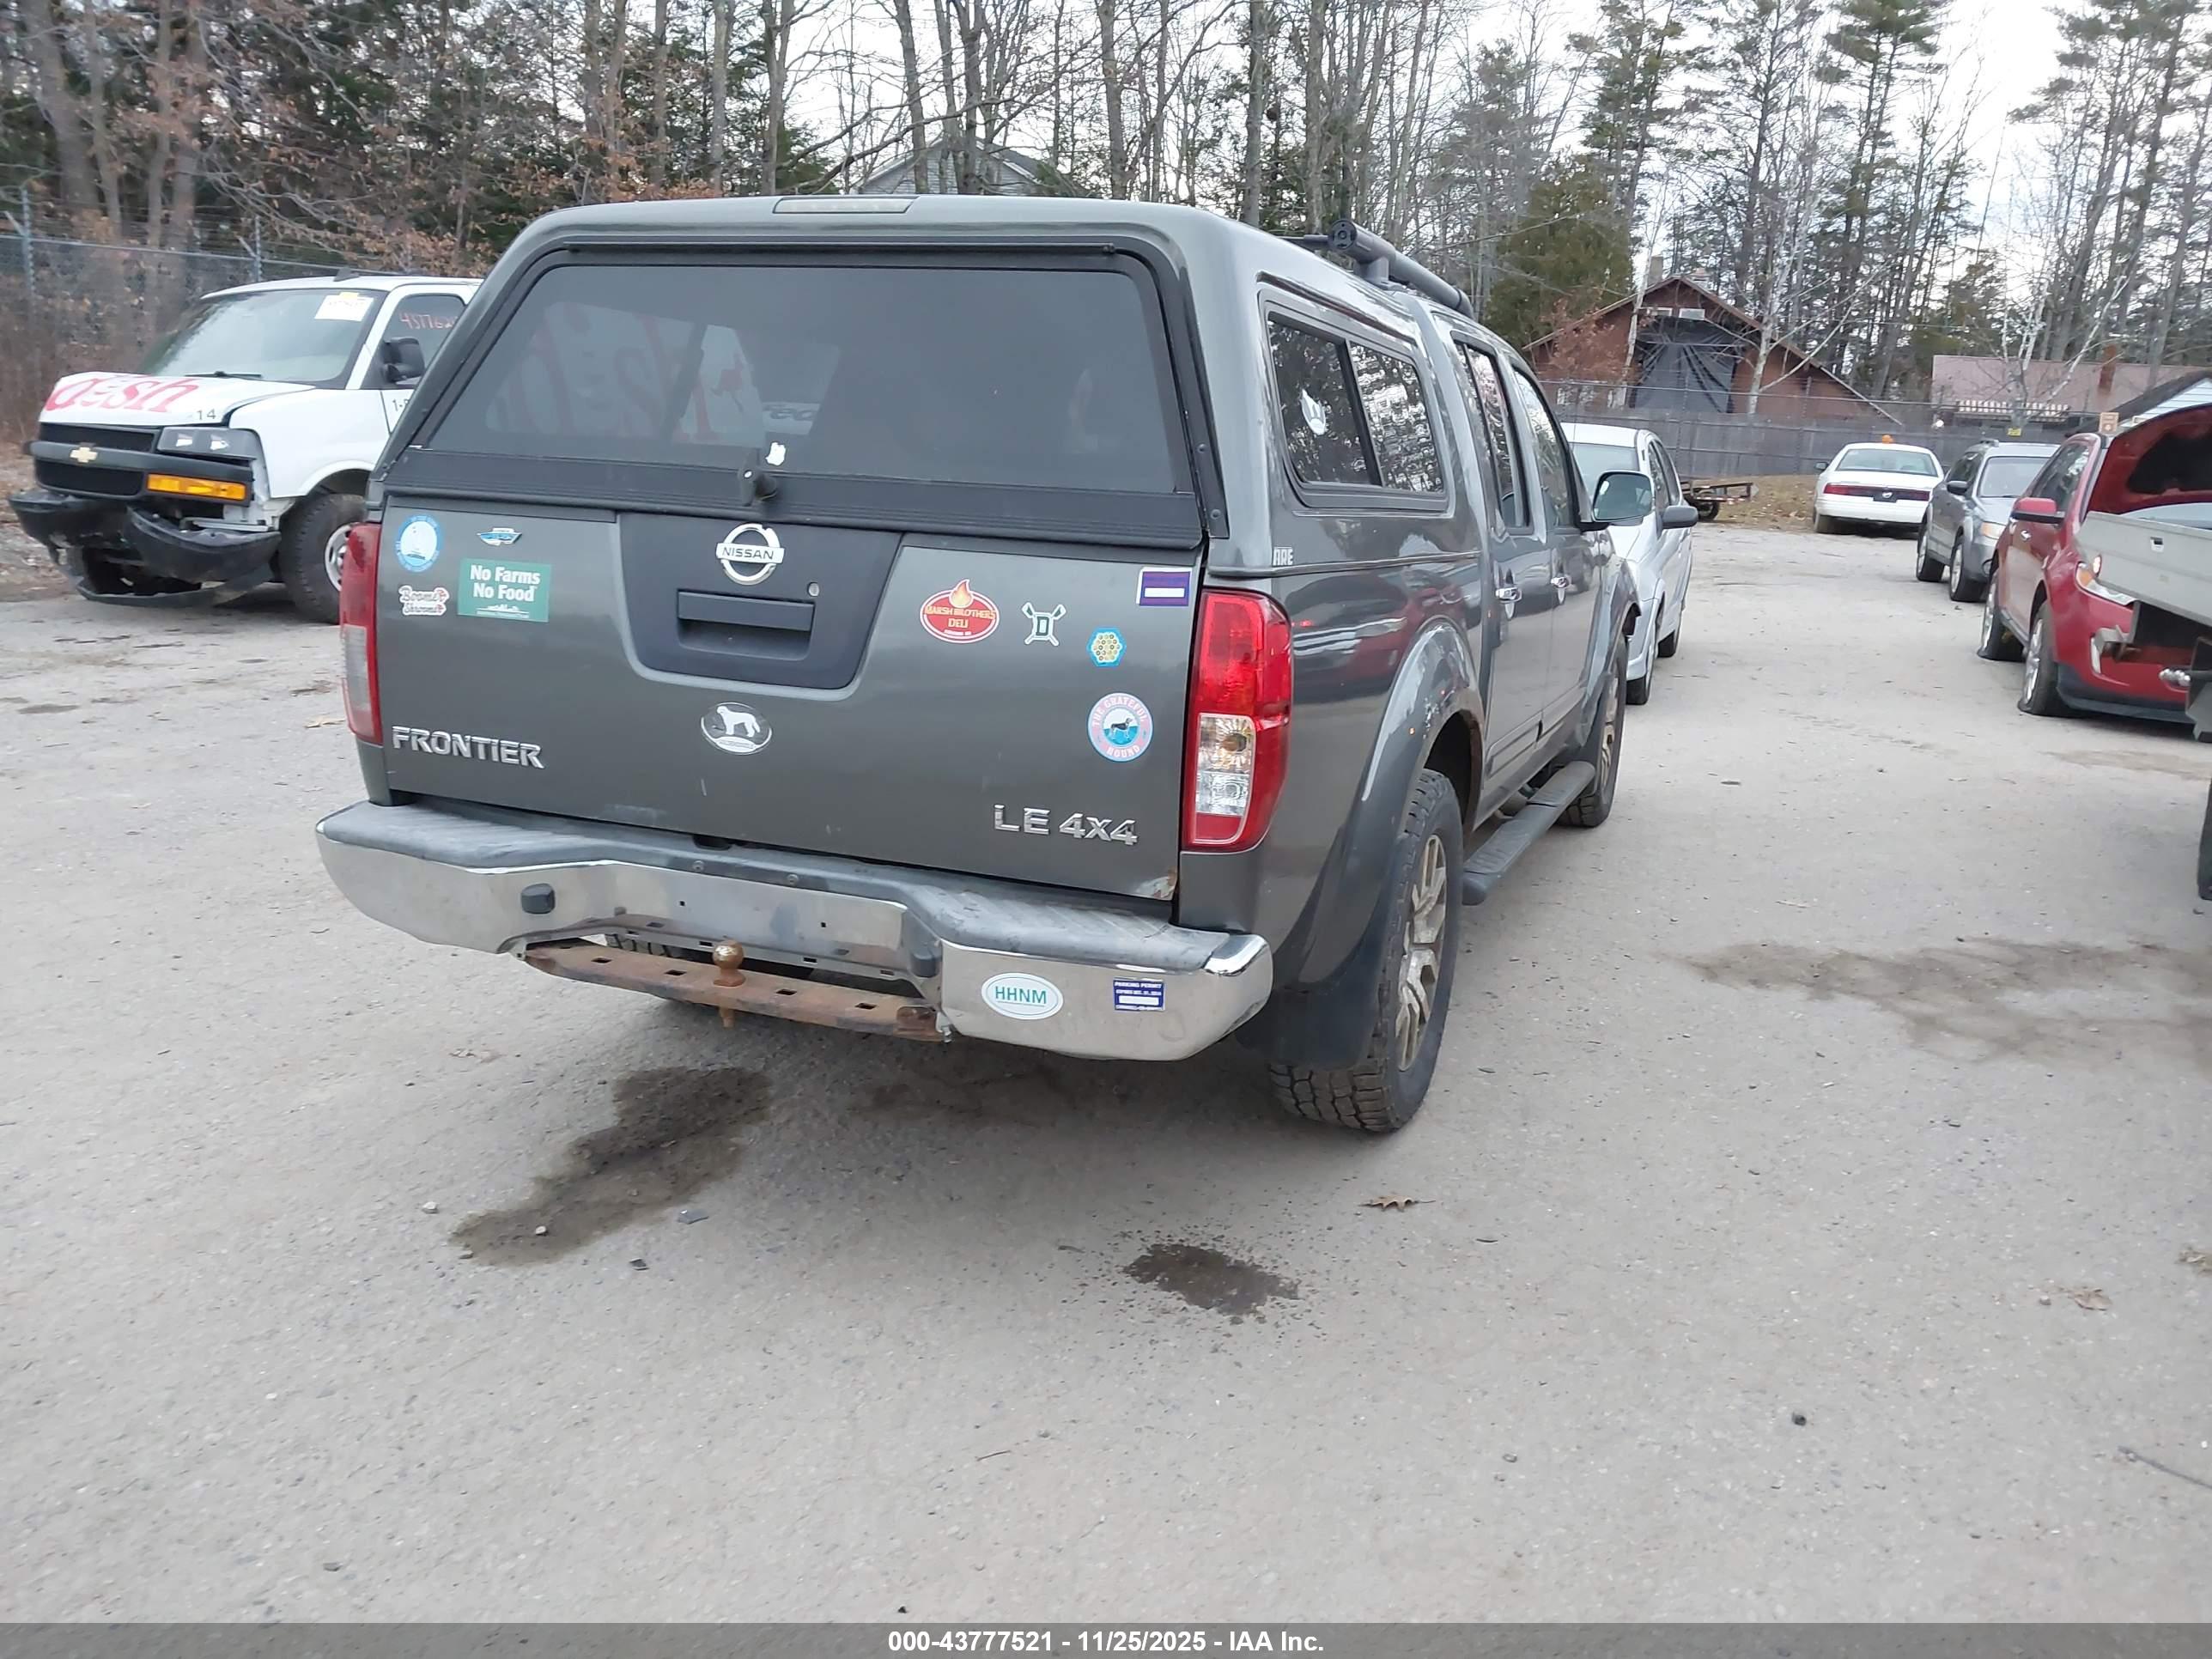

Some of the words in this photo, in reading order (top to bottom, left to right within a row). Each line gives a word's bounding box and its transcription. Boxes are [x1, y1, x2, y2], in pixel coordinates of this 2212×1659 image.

[197, 410, 216, 420] 14
[722, 547, 774, 560] NISSAN
[1273, 548, 1293, 566] ARE
[471, 564, 491, 581] No
[495, 567, 541, 585] Farms
[473, 583, 495, 599] No
[498, 585, 535, 602] Food
[948, 618, 969, 629] DELI
[1036, 616, 1048, 636] D
[1092, 707, 1106, 726] THE
[1104, 696, 1148, 721] GRATEFUL
[392, 726, 545, 769] FRONTIER
[1106, 745, 1140, 757] HOUND
[994, 804, 1050, 835] LE
[995, 986, 1047, 1005] HHNM
